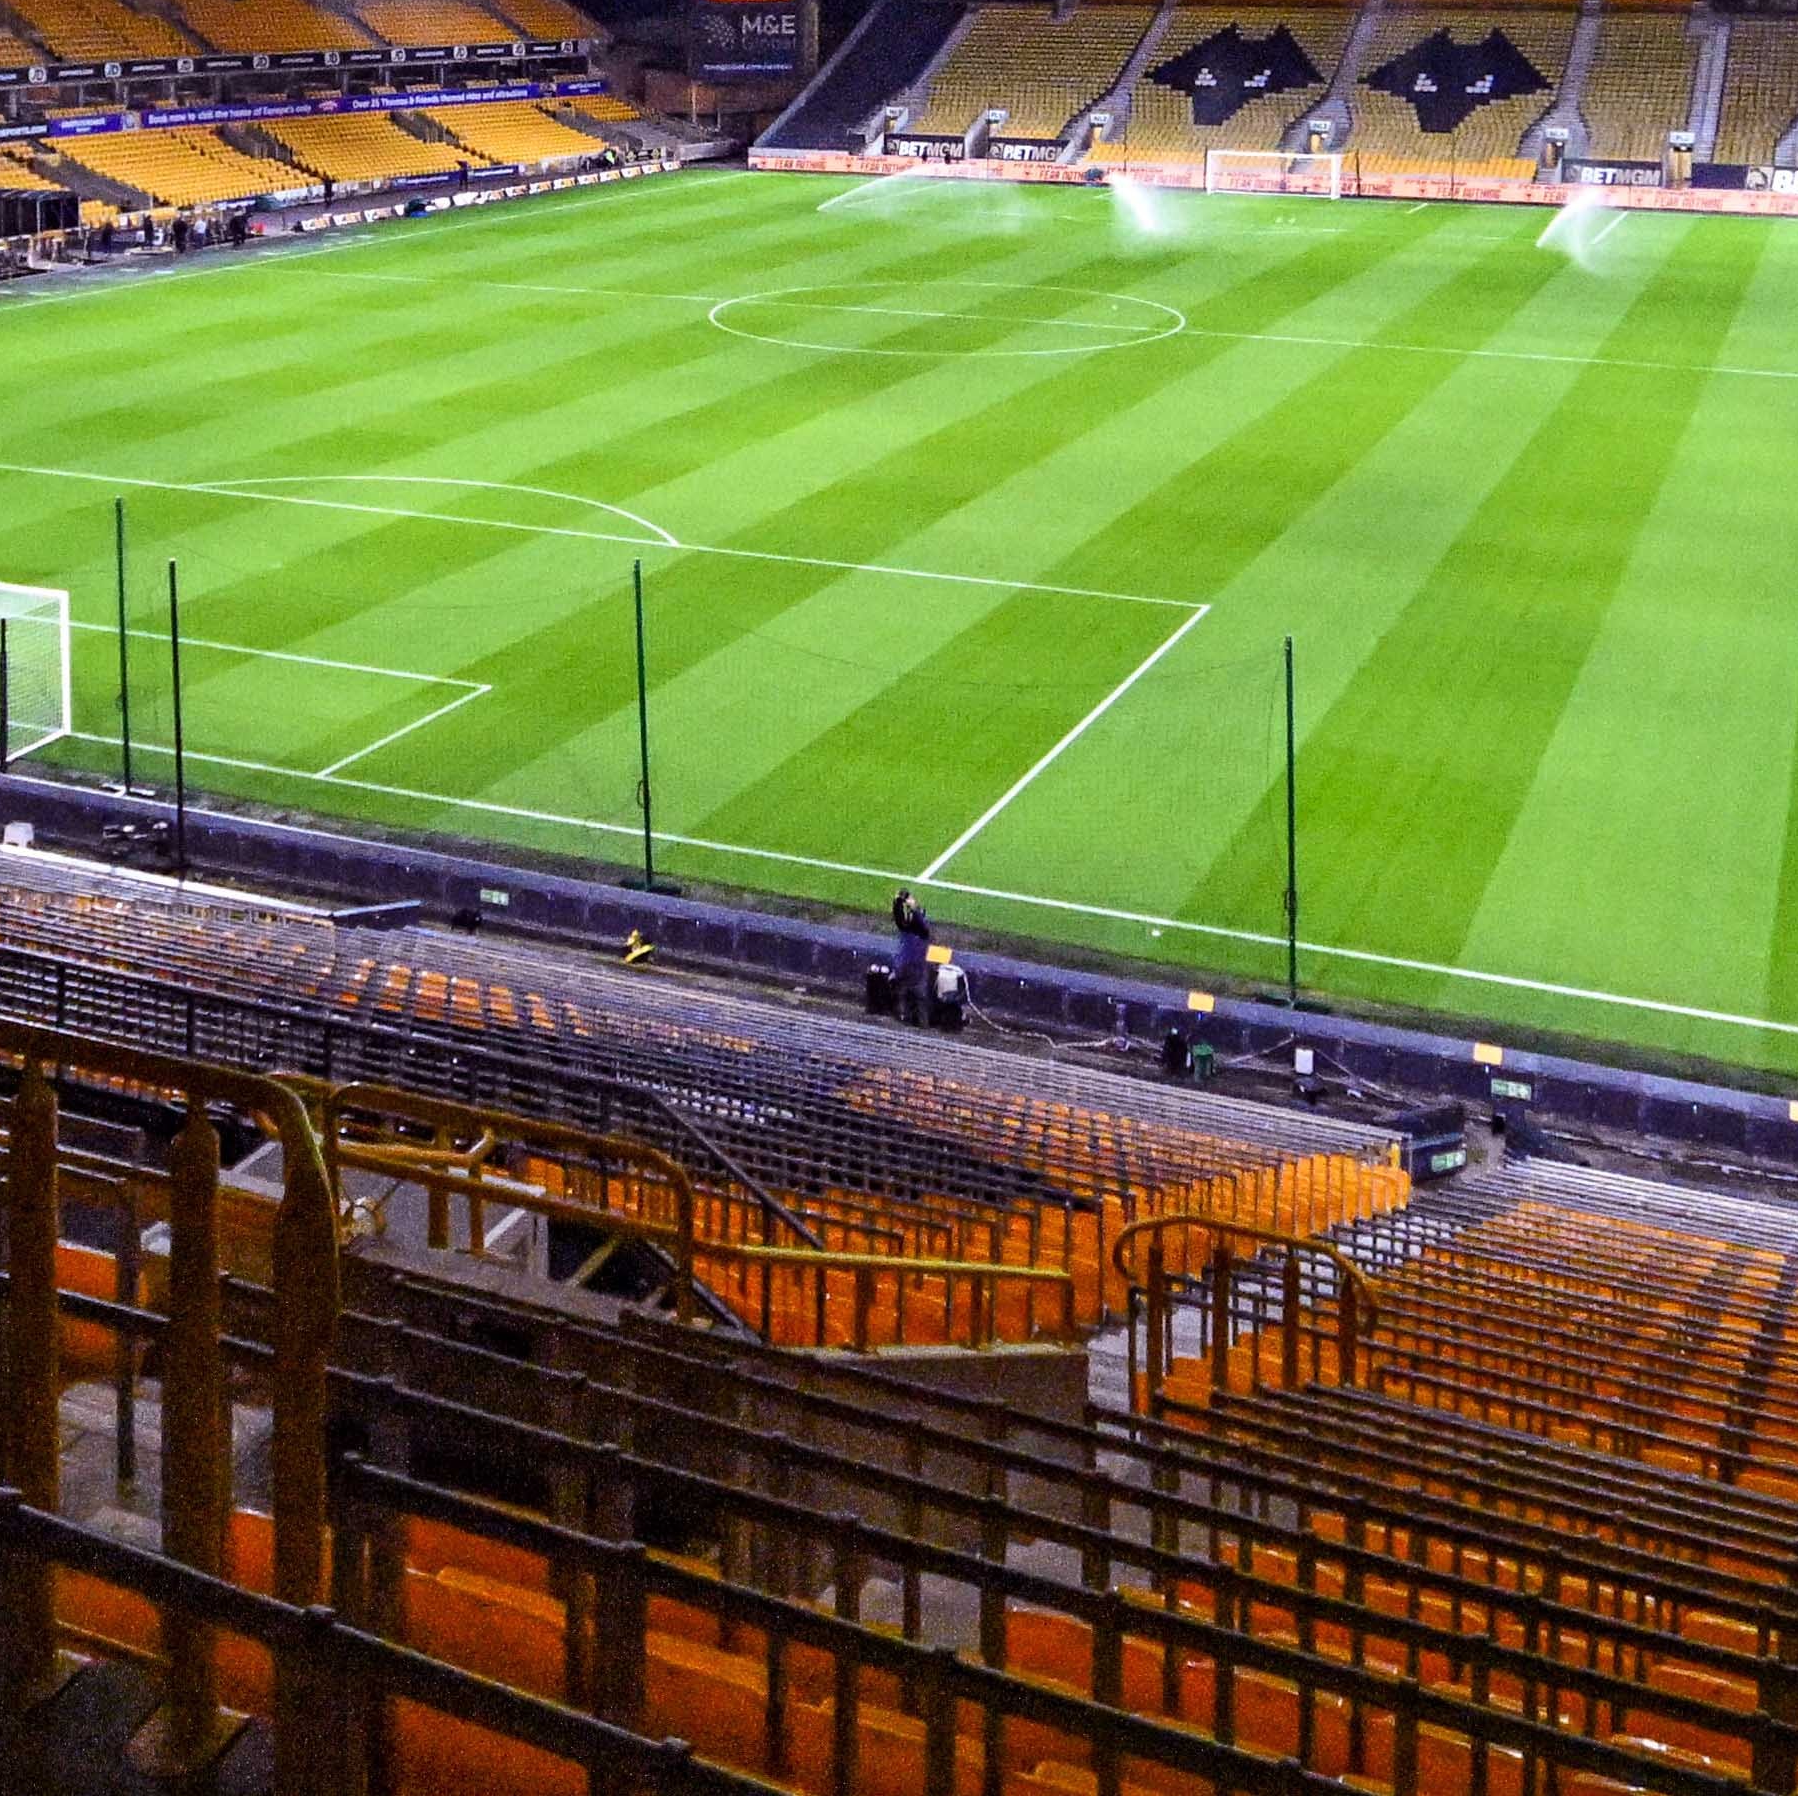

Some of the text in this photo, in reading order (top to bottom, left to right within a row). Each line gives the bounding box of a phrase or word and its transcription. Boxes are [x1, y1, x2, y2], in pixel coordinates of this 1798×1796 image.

[741, 14, 796, 35] M&E
[899, 141, 964, 158] BETMGM
[1040, 169, 1060, 179] FEAR
[1581, 165, 1661, 185] BETMGM
